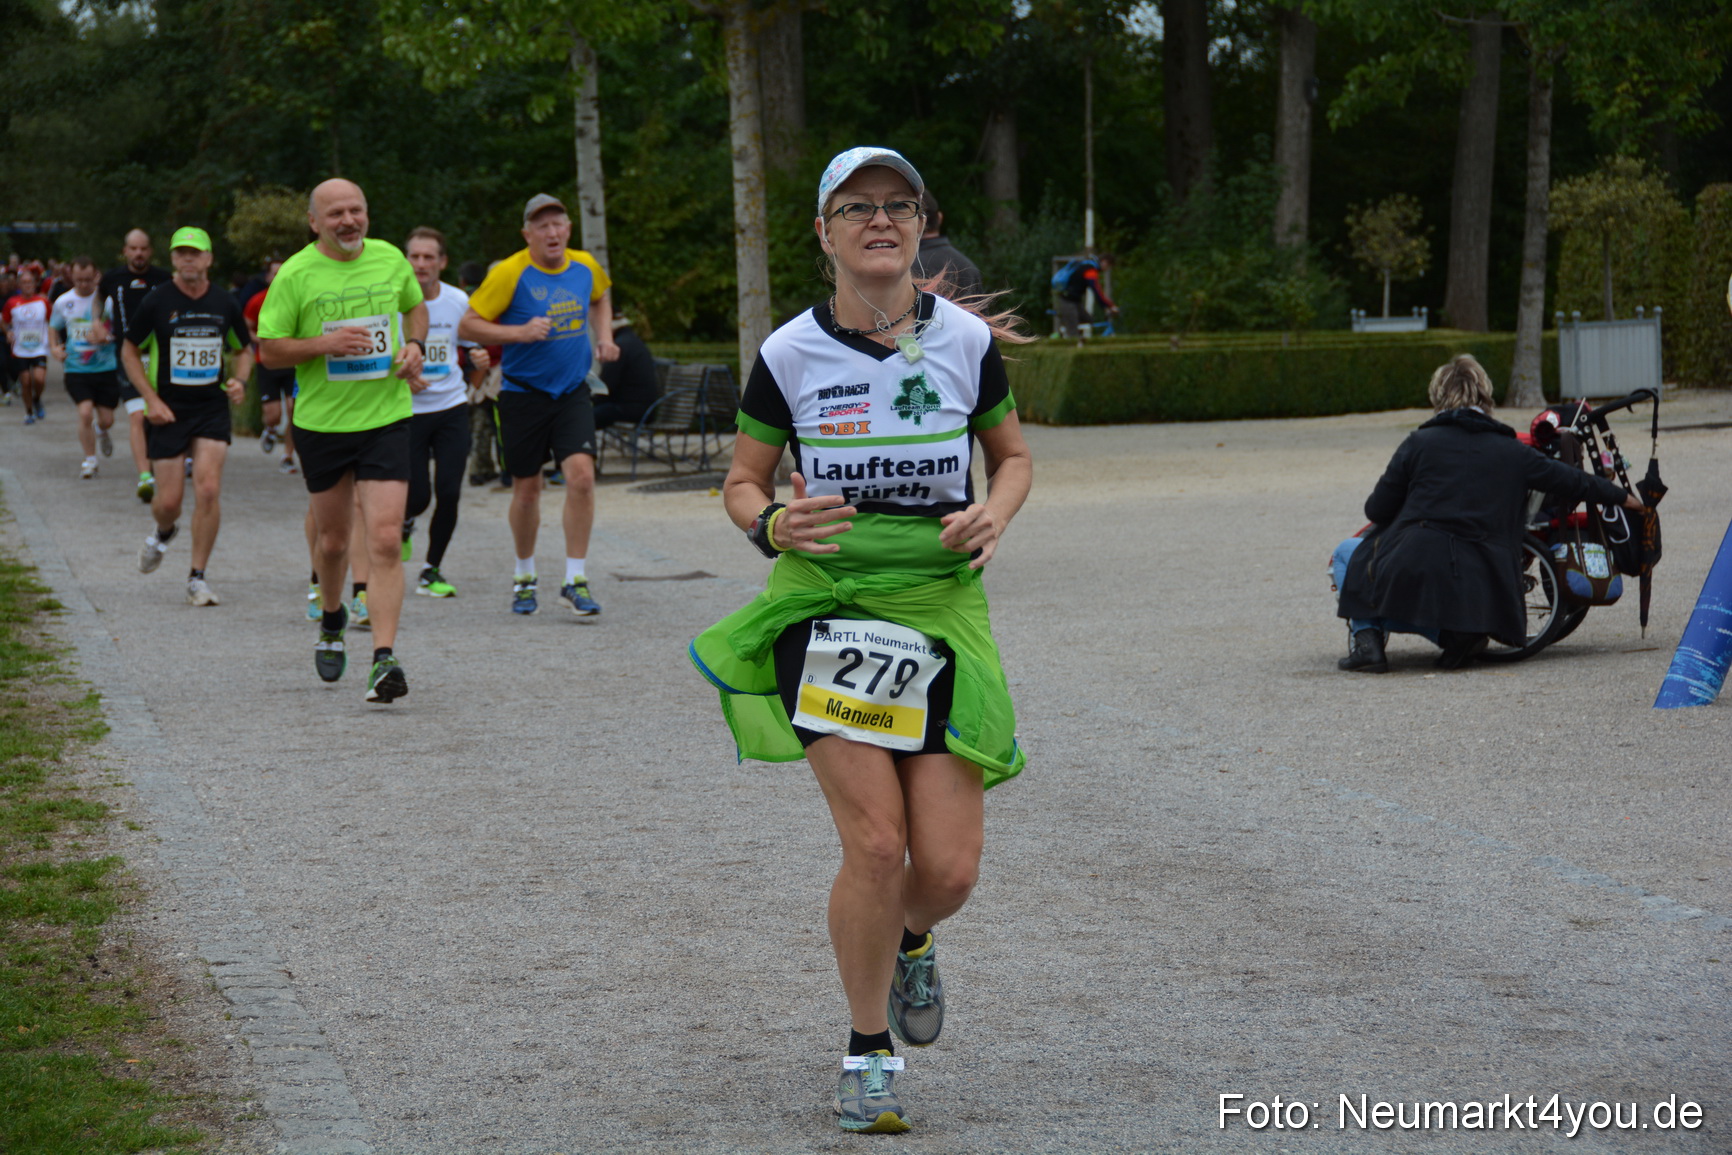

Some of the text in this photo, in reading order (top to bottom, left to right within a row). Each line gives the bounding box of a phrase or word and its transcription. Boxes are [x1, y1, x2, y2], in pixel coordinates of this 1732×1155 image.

[176, 349, 218, 367] 2185
[420, 346, 447, 362] 06
[346, 361, 378, 373] Robert
[818, 420, 871, 436] OBI
[813, 455, 959, 481] Laufteam
[841, 482, 931, 504] Fürth
[814, 631, 927, 655] PARTL Neumarkt
[807, 674, 814, 683] D
[832, 647, 920, 699] 279
[825, 697, 894, 729] Manuela
